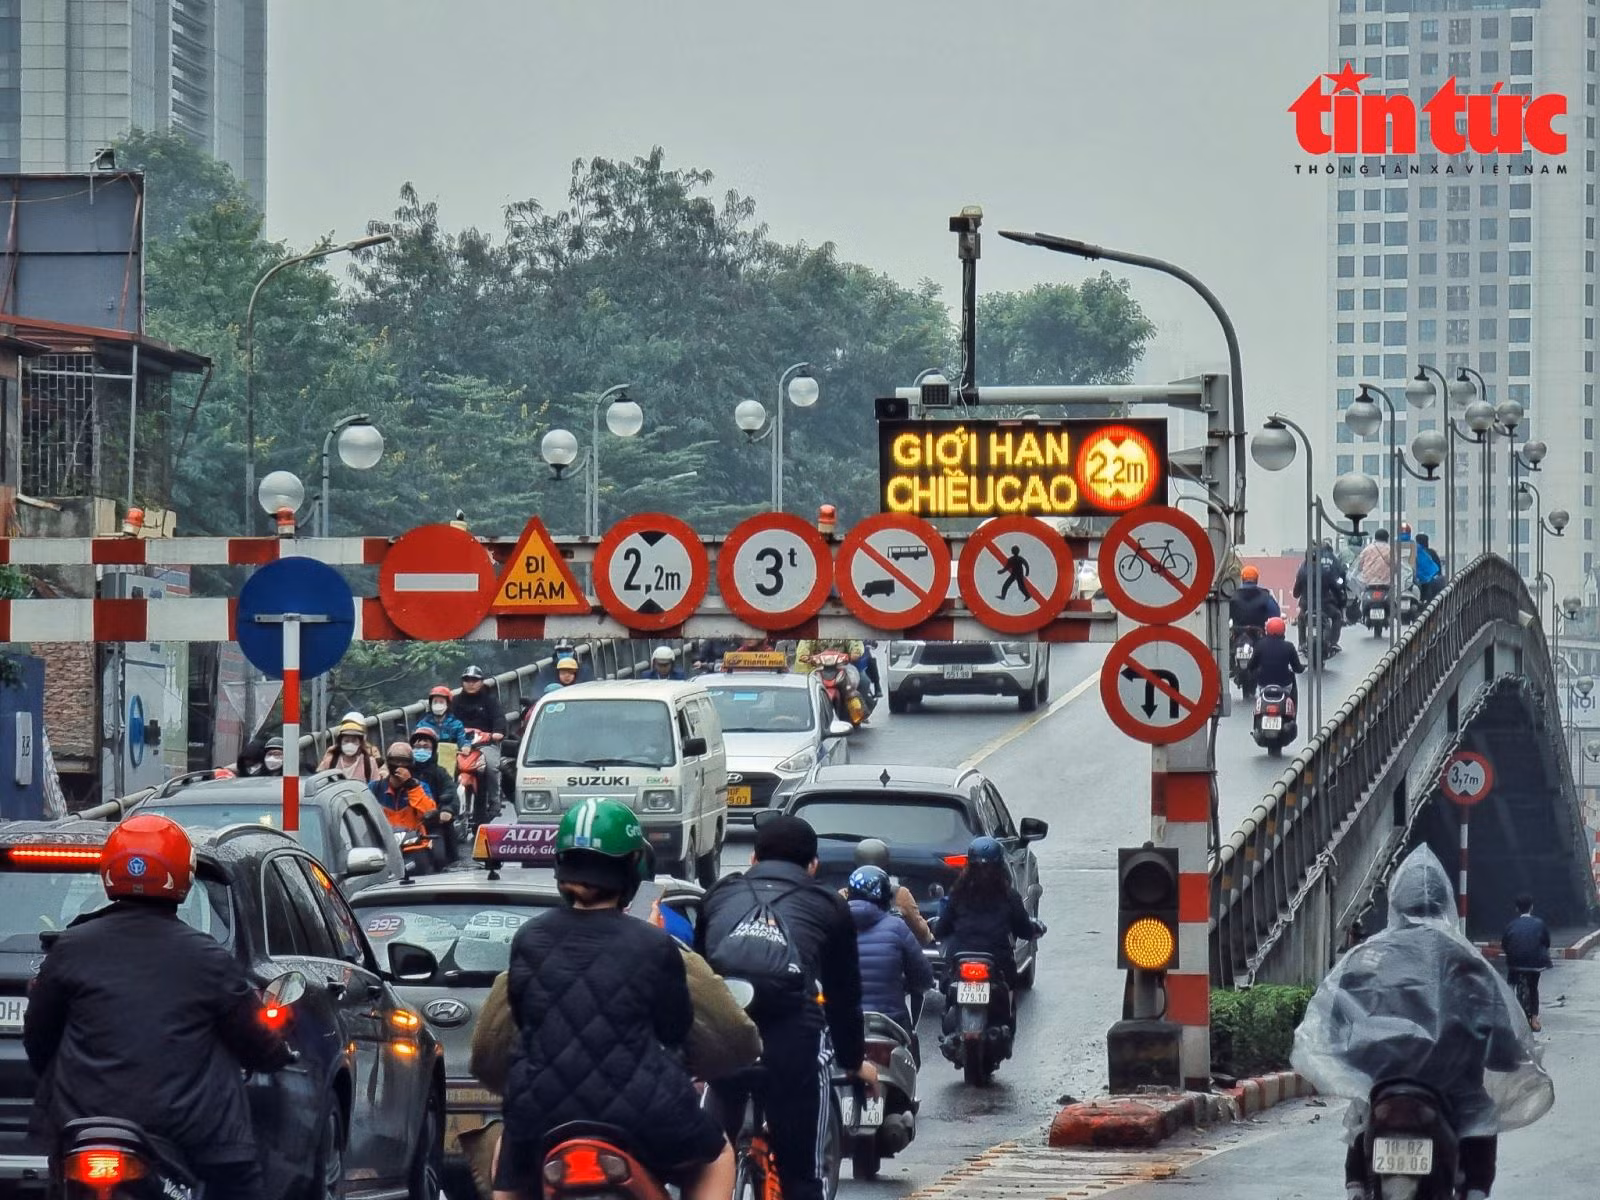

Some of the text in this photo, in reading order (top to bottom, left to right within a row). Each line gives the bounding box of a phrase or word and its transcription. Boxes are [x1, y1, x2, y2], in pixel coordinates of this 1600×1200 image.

[893, 426, 977, 466] GIỚI
[989, 431, 1069, 467] HẠN
[525, 555, 545, 574] ĐI
[623, 547, 681, 595] 2,2m
[505, 578, 565, 604] CHẬM
[567, 776, 630, 786] SUZUKI
[1452, 766, 1479, 788] 3,7m
[502, 829, 539, 841] ALO
[499, 844, 518, 855] Giá
[367, 918, 401, 932] 392
